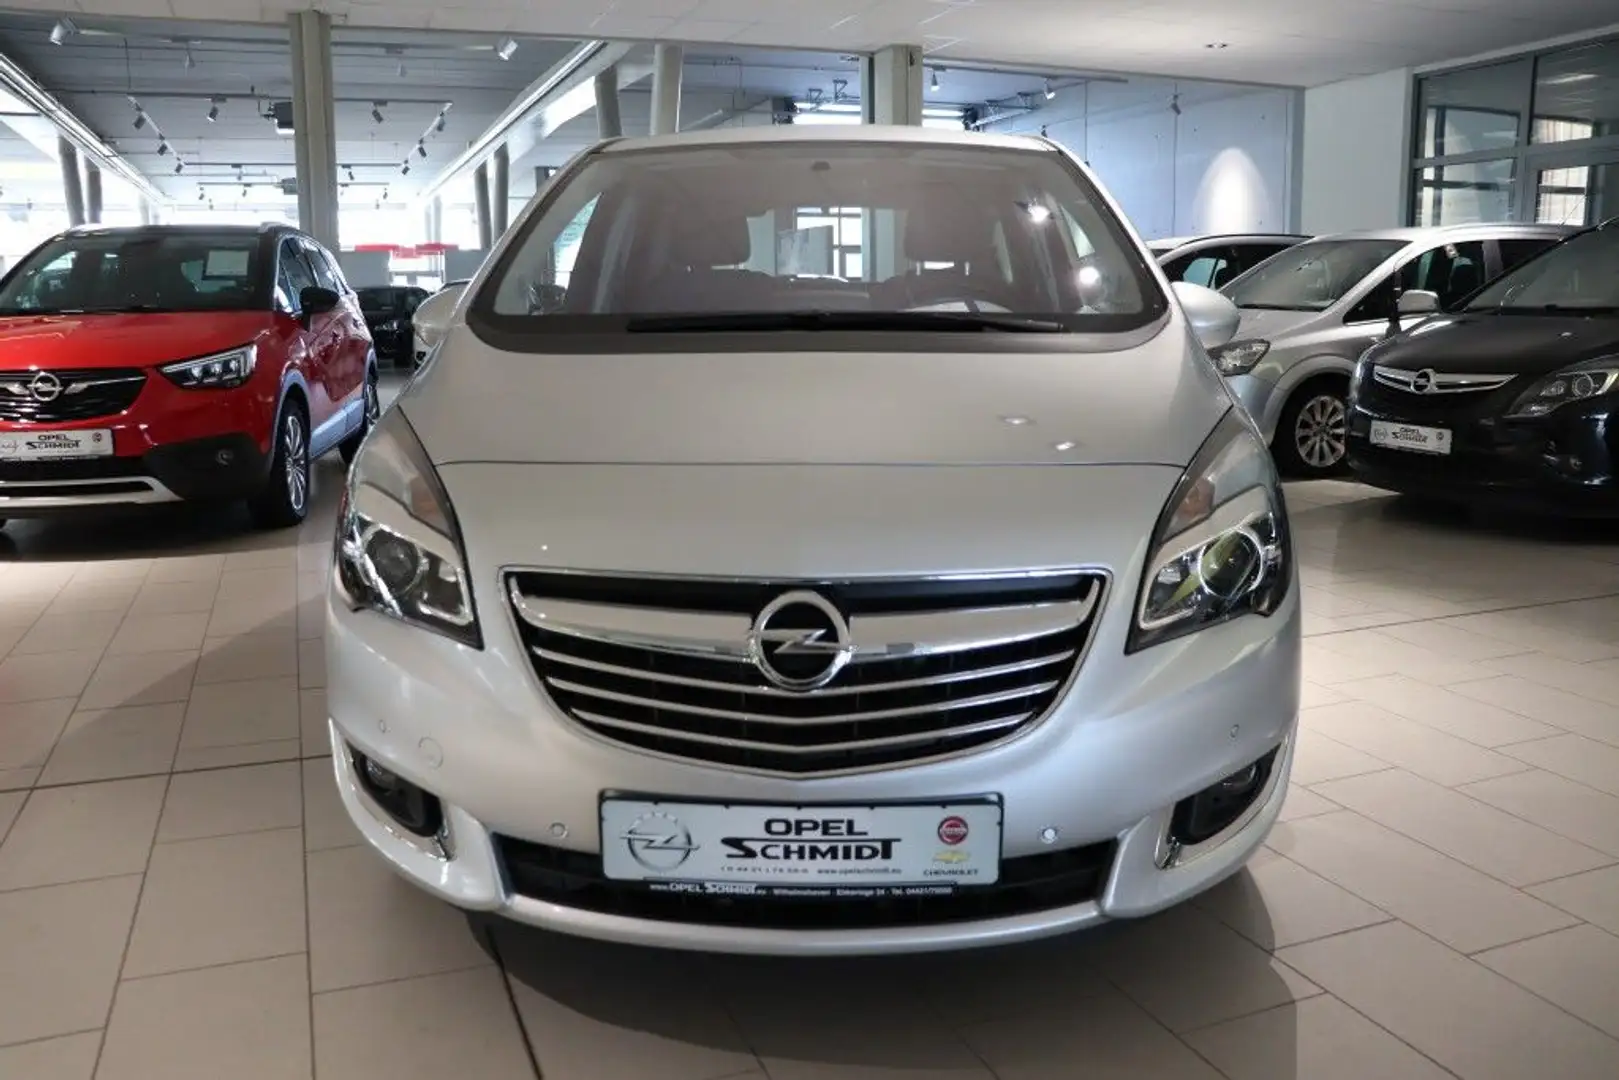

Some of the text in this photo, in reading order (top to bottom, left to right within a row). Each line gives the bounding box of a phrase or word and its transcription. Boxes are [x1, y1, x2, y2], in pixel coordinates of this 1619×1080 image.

[25, 440, 81, 450] SCHMIDT
[764, 818, 868, 837] OPEL
[720, 837, 902, 860] SCHMIDT
[923, 868, 978, 877] CHEVROLET
